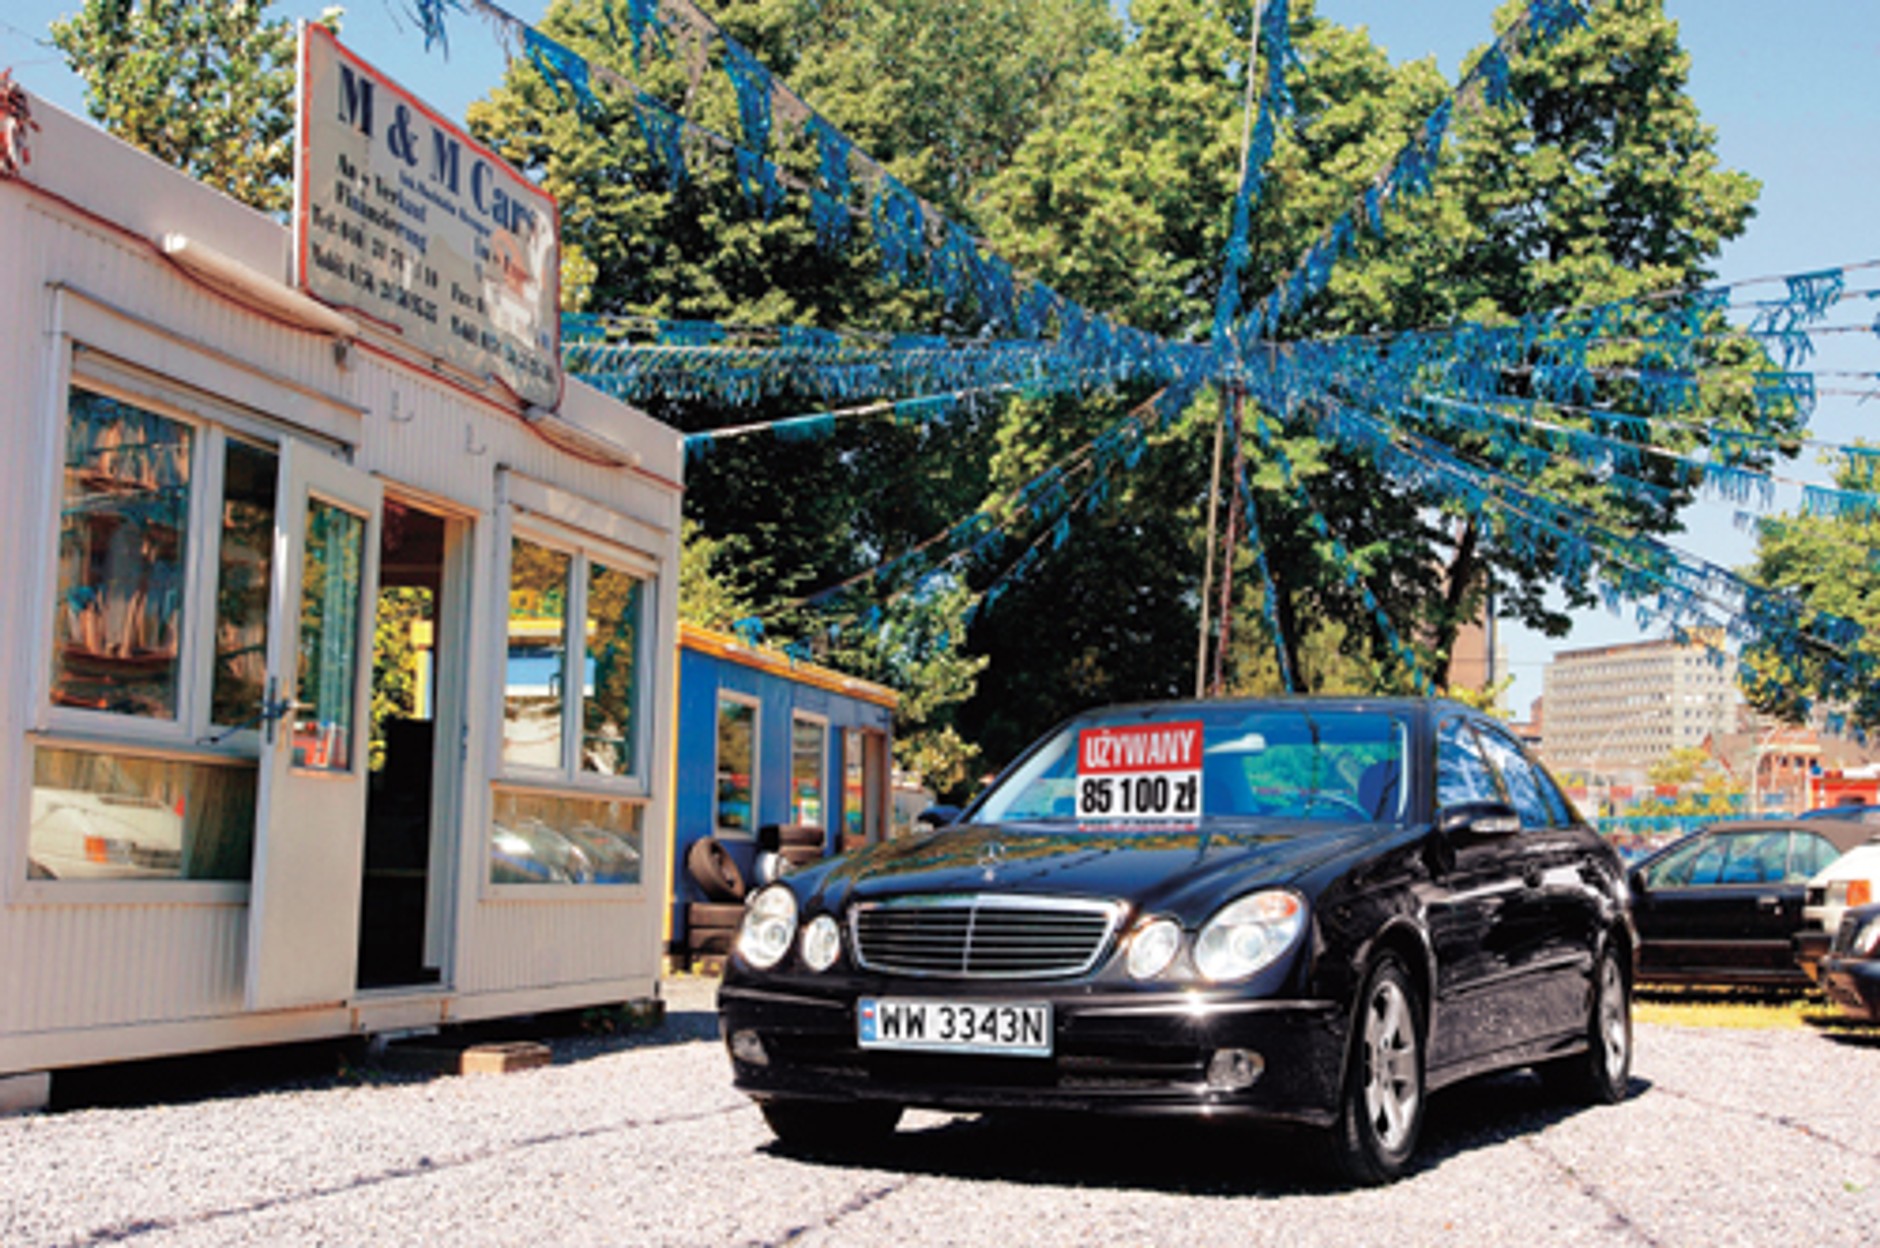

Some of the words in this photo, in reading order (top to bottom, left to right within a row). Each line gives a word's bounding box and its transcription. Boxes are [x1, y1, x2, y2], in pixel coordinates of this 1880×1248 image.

[337, 62, 376, 136] M
[386, 105, 418, 167] &
[429, 126, 462, 196] M
[1085, 729, 1196, 768] UŻYWANY
[1081, 778, 1113, 813] 85
[1120, 775, 1169, 813] 100
[1173, 775, 1197, 812] zł
[880, 1005, 927, 1038] WW
[938, 1006, 1043, 1044] 3343N
